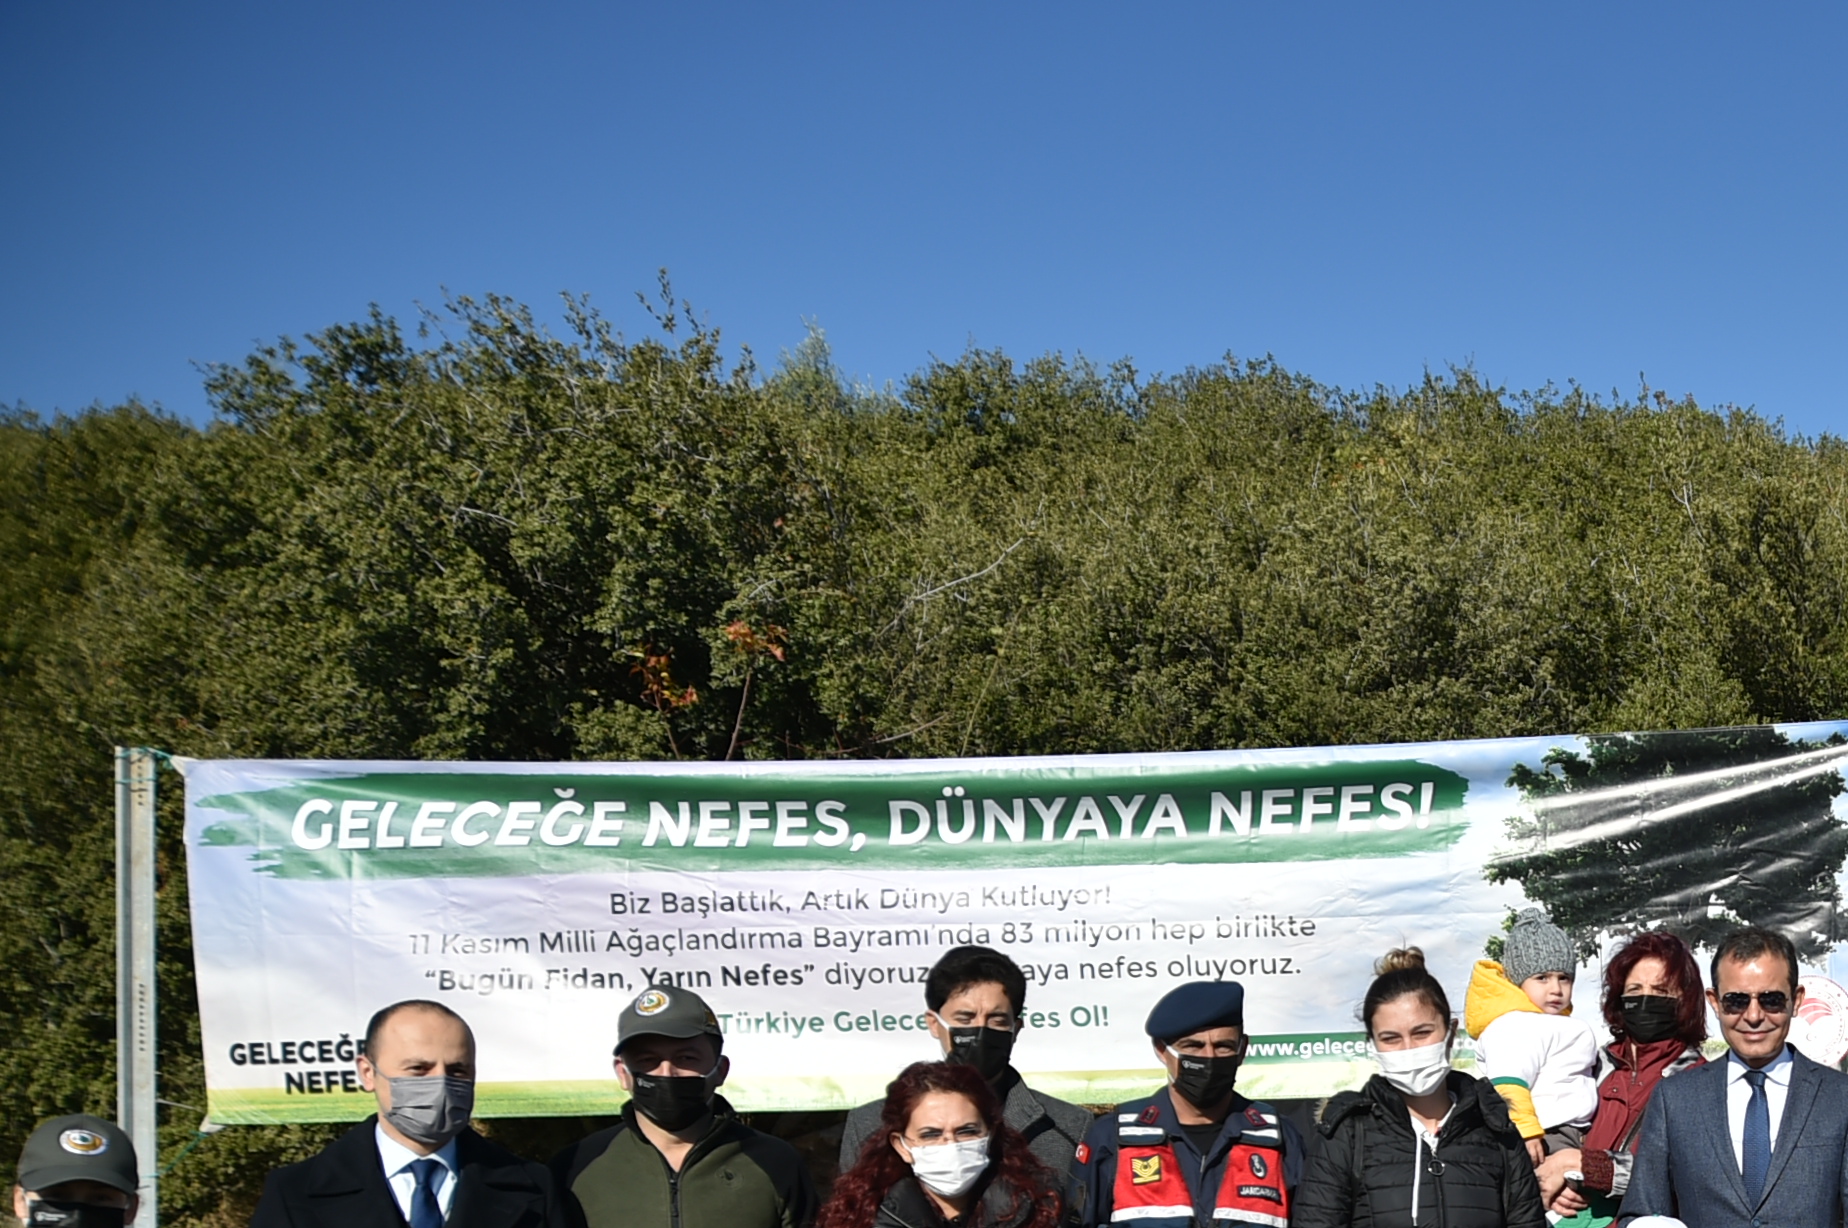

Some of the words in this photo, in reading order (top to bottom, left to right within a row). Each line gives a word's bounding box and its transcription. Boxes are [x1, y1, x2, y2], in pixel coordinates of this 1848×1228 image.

[291, 787, 626, 850] GELECEĞE
[641, 799, 867, 852] NEFES,
[887, 786, 1188, 845] DÜNYAYA
[1207, 782, 1434, 837] NEFES!
[611, 892, 651, 915] Biz
[661, 891, 791, 919] Başlattık,
[801, 888, 870, 912] Artık
[880, 887, 970, 914] Dünya
[981, 885, 1111, 911] Kutluyor!
[408, 934, 430, 955] 11
[440, 932, 530, 956] Kasım
[539, 928, 596, 954] Milli
[605, 926, 802, 957] Ağaçlandırma
[1000, 922, 1033, 944] 83
[1045, 920, 1141, 948] milyon
[1151, 918, 1205, 945] hep
[1216, 915, 1317, 939] birlikte
[640, 967, 712, 988] Yarın
[1079, 956, 1158, 980] nefes
[1167, 954, 1302, 982] oluyoruz.
[718, 1011, 825, 1038] Türkiye
[833, 1009, 929, 1032] Gelece
[1021, 1005, 1061, 1028] fes
[1070, 1005, 1109, 1027] Ol!
[284, 1070, 374, 1095] NEFE
